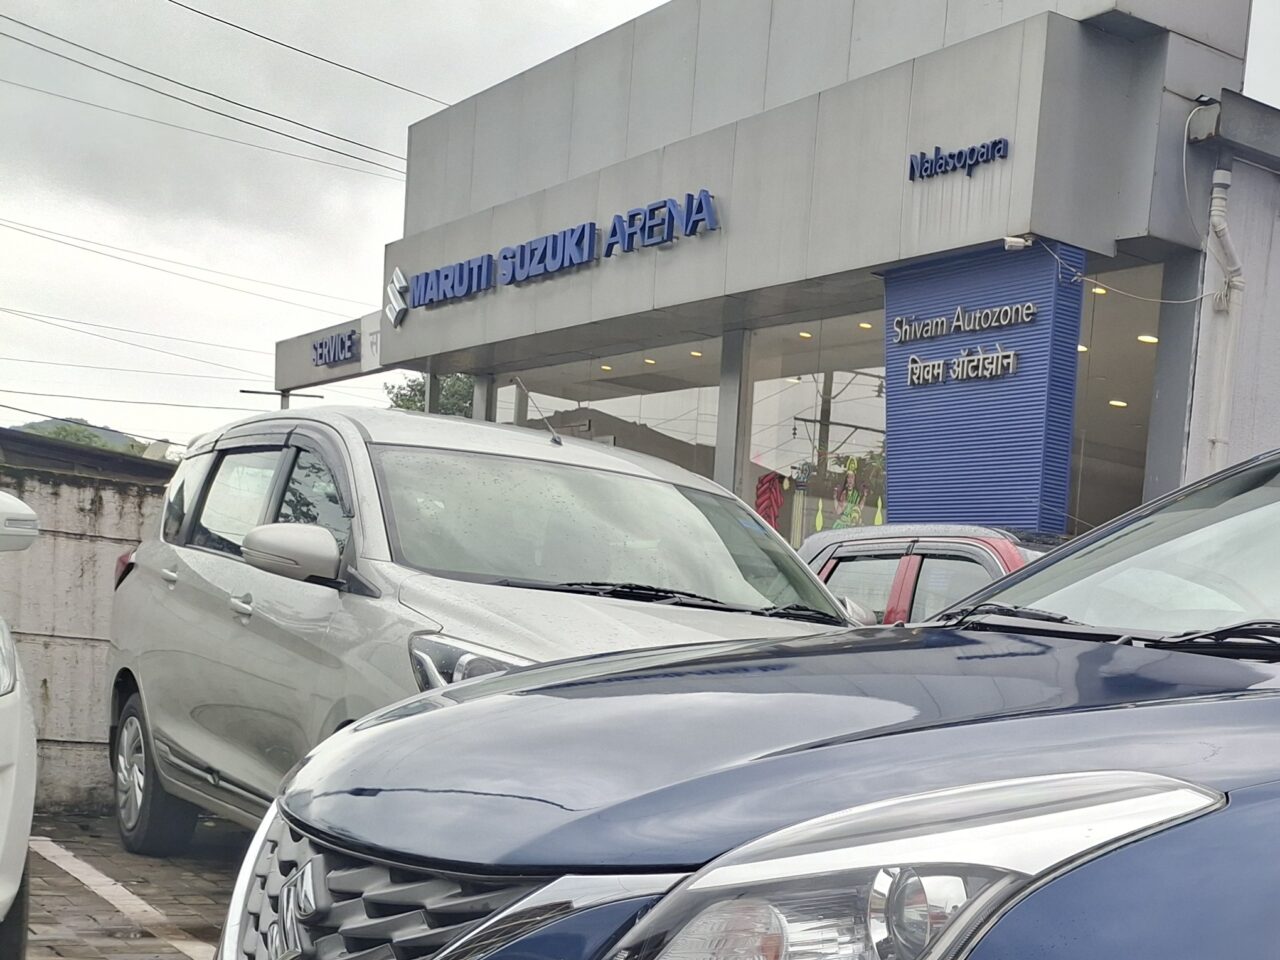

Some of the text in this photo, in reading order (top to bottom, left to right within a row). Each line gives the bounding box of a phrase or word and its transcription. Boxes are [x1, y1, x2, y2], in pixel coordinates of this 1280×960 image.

[909, 138, 1008, 181] Nalasopara
[410, 189, 718, 308] MARUTI SUZUKI ARENA
[892, 302, 1036, 344] Shivam Autozone
[312, 331, 354, 367] SERVICE
[907, 353, 944, 386] शिवम
